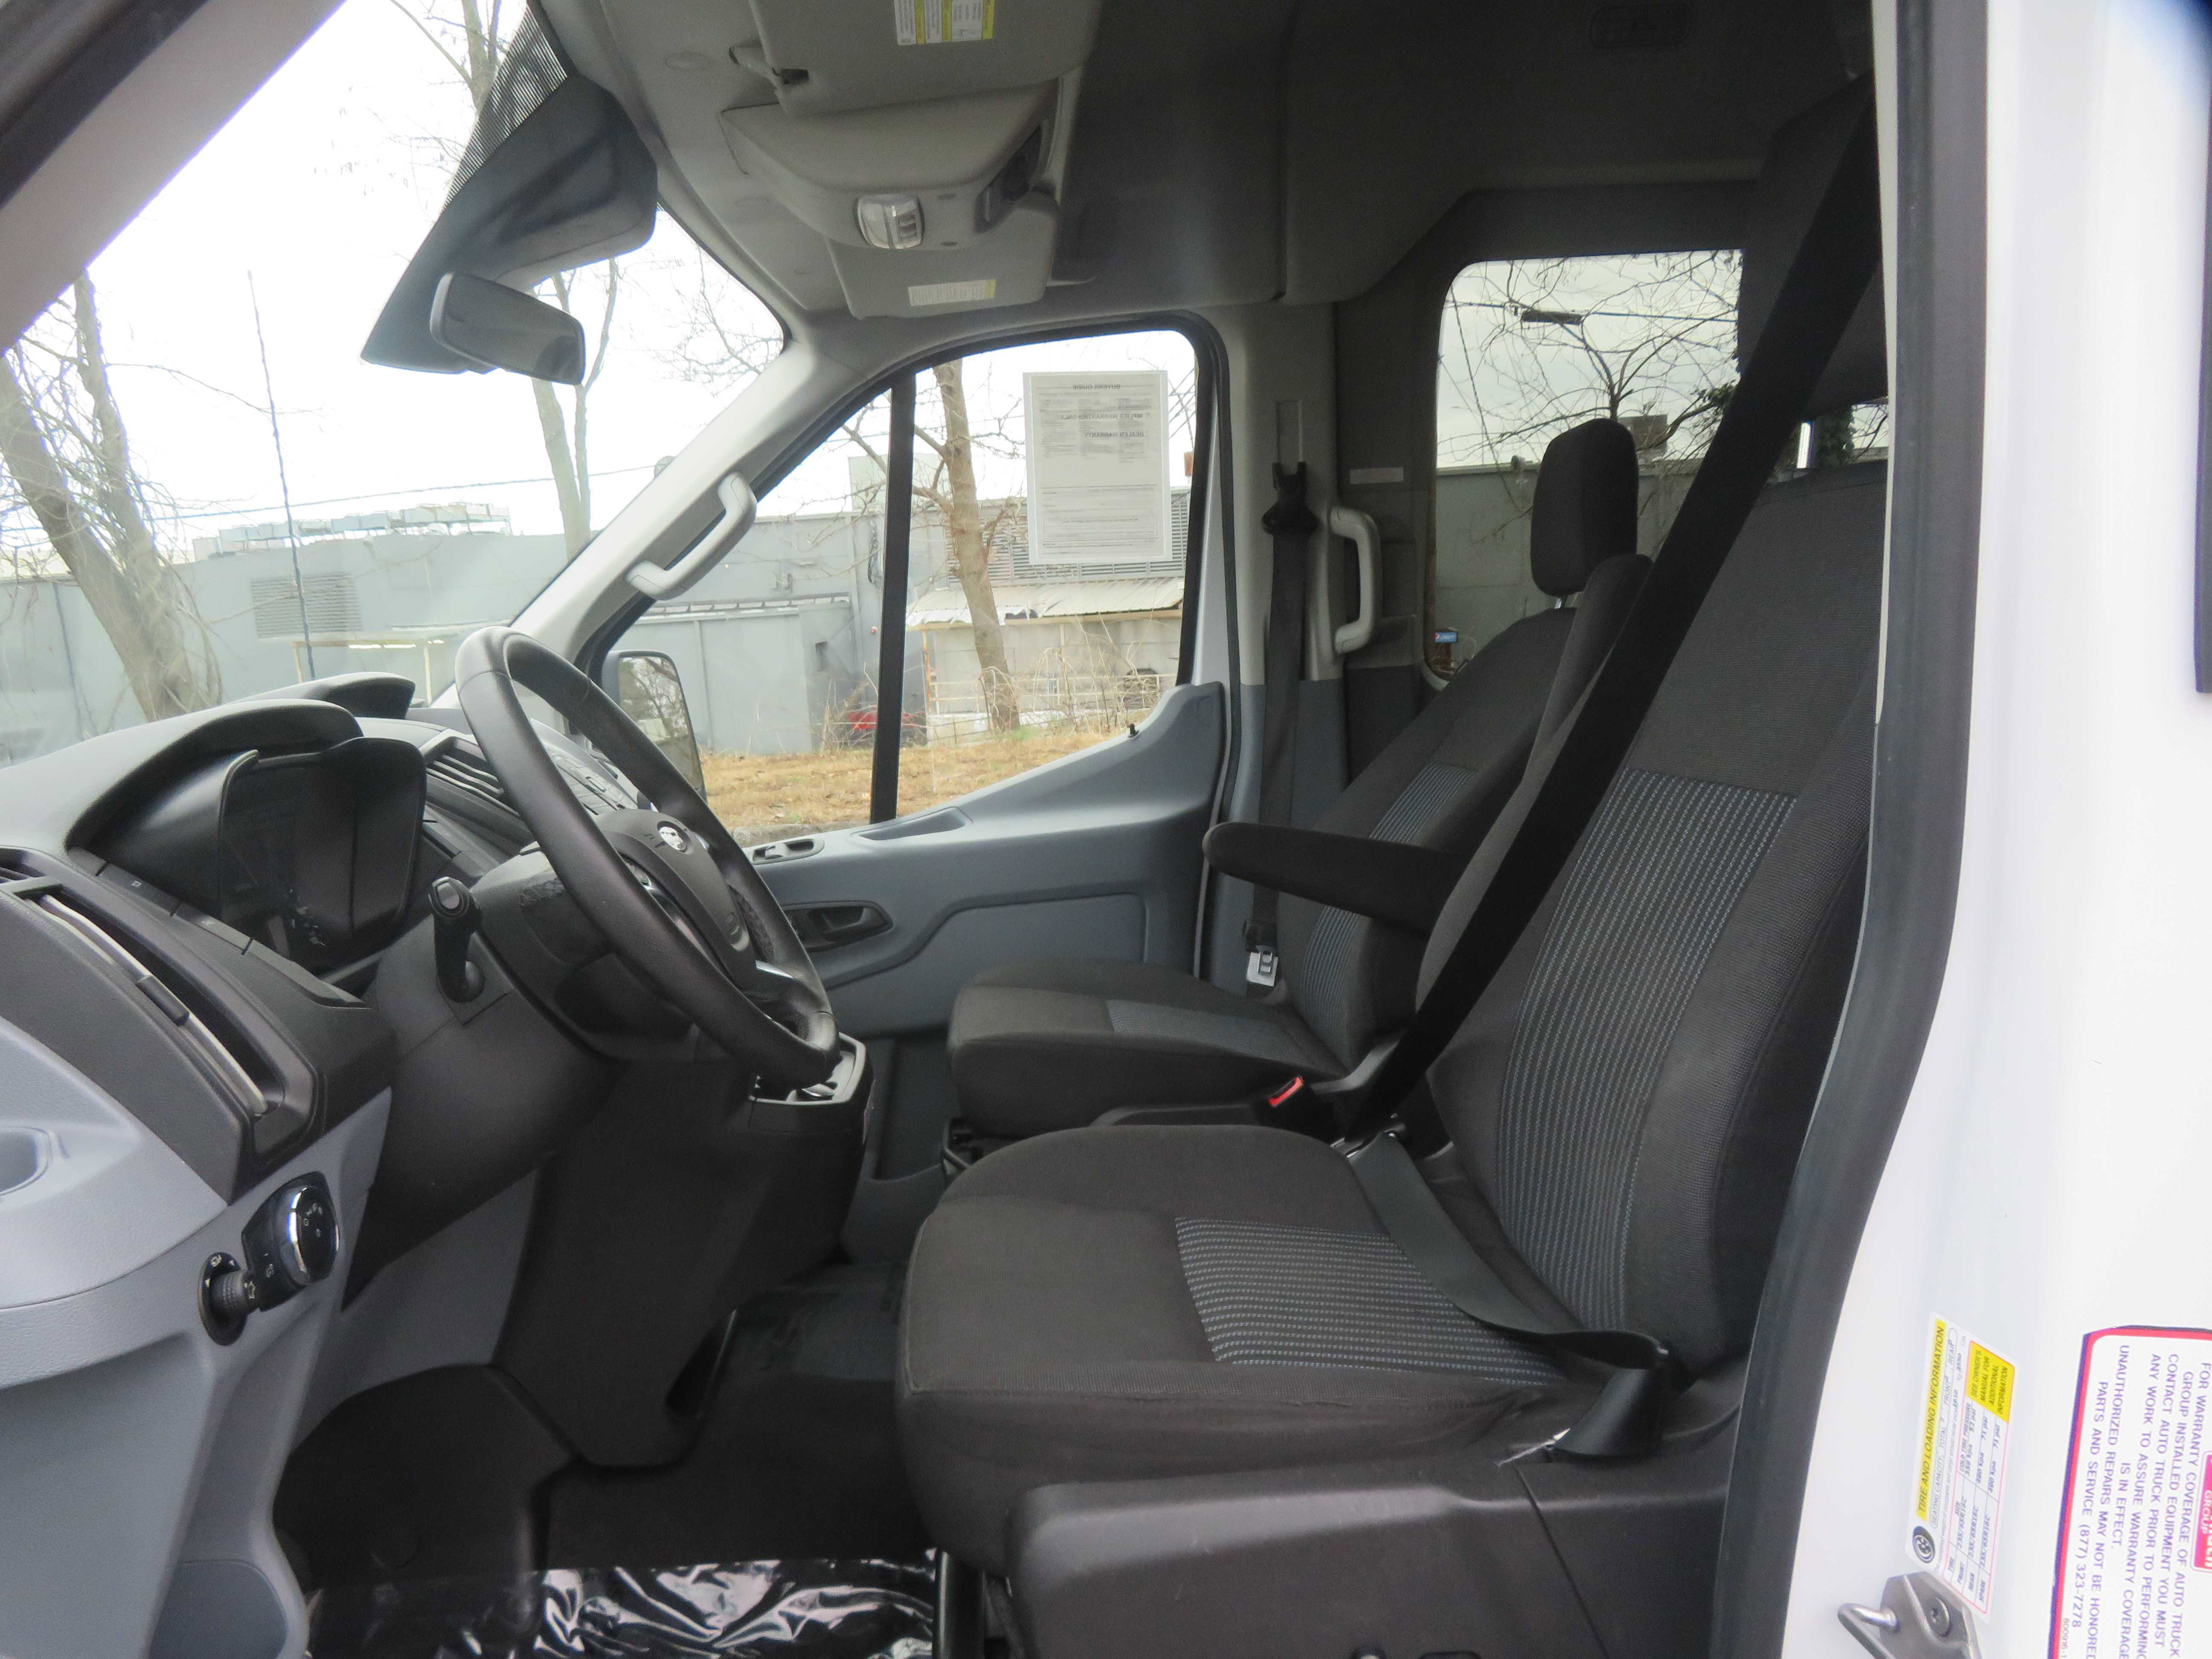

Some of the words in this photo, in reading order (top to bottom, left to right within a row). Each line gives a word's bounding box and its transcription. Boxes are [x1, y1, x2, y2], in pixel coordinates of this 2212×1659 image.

[1930, 1326, 1944, 1405] INFORMATION
[2149, 1353, 2161, 1380] ANY
[2162, 1353, 2179, 1415] CONTACT
[2198, 1362, 2211, 1388] FOR
[1980, 1374, 1988, 1401] MANUAL
[1989, 1365, 1999, 1406] ADDITIONAL
[1997, 1366, 2008, 1414] INFORMATION
[2093, 1382, 2108, 1422] PARTS
[2107, 1345, 2130, 1446] UNAUTHORIZED
[2179, 1371, 2194, 1417] GROUP
[2143, 1386, 2157, 1425] WORK
[1924, 1407, 1936, 1458] LOADING
[2090, 1428, 2102, 1455] AND
[2140, 1431, 2152, 1448] TO
[2157, 1420, 2170, 1454] AUTO
[2188, 1395, 2207, 1467] WARRANTY
[1921, 1460, 1930, 1487] AND
[2120, 1462, 2131, 1474] IS
[2169, 1422, 2187, 1490] INSTALLED
[2082, 1461, 2098, 1516] SERVICE
[2100, 1451, 2116, 1505] REPAIRS
[2118, 1479, 2128, 1491] IN
[2132, 1453, 2148, 1506] ASSURE
[2151, 1460, 2165, 1503] TRUCK
[1918, 1487, 1926, 1512] TIRE
[1931, 1495, 1939, 1525] SEATING
[2179, 1472, 2197, 1543] COVERAGE
[2201, 1490, 2212, 1534] GROUP
[2075, 1524, 2091, 1559] (877)
[2096, 1511, 2108, 1537] MAY
[2110, 1498, 2126, 1549] EFFECT.
[2145, 1509, 2159, 1548] PRIOR
[2160, 1497, 2177, 1572] EQUIPMENT
[2093, 1543, 2104, 1569] NOT
[2125, 1512, 2141, 1583] WARRANTY
[2143, 1554, 2155, 1571] TO
[2177, 1549, 2188, 1567] OF
[2071, 1564, 2087, 1627] 323-7278
[2091, 1575, 2102, 1592] BE
[2157, 1578, 2169, 1604] YOU
[2173, 1572, 2186, 1607] AUTO
[2118, 1589, 2134, 1659] COVERAGE
[2154, 1610, 2166, 1647] MUST
[2170, 1613, 2183, 1658] TRUCK
